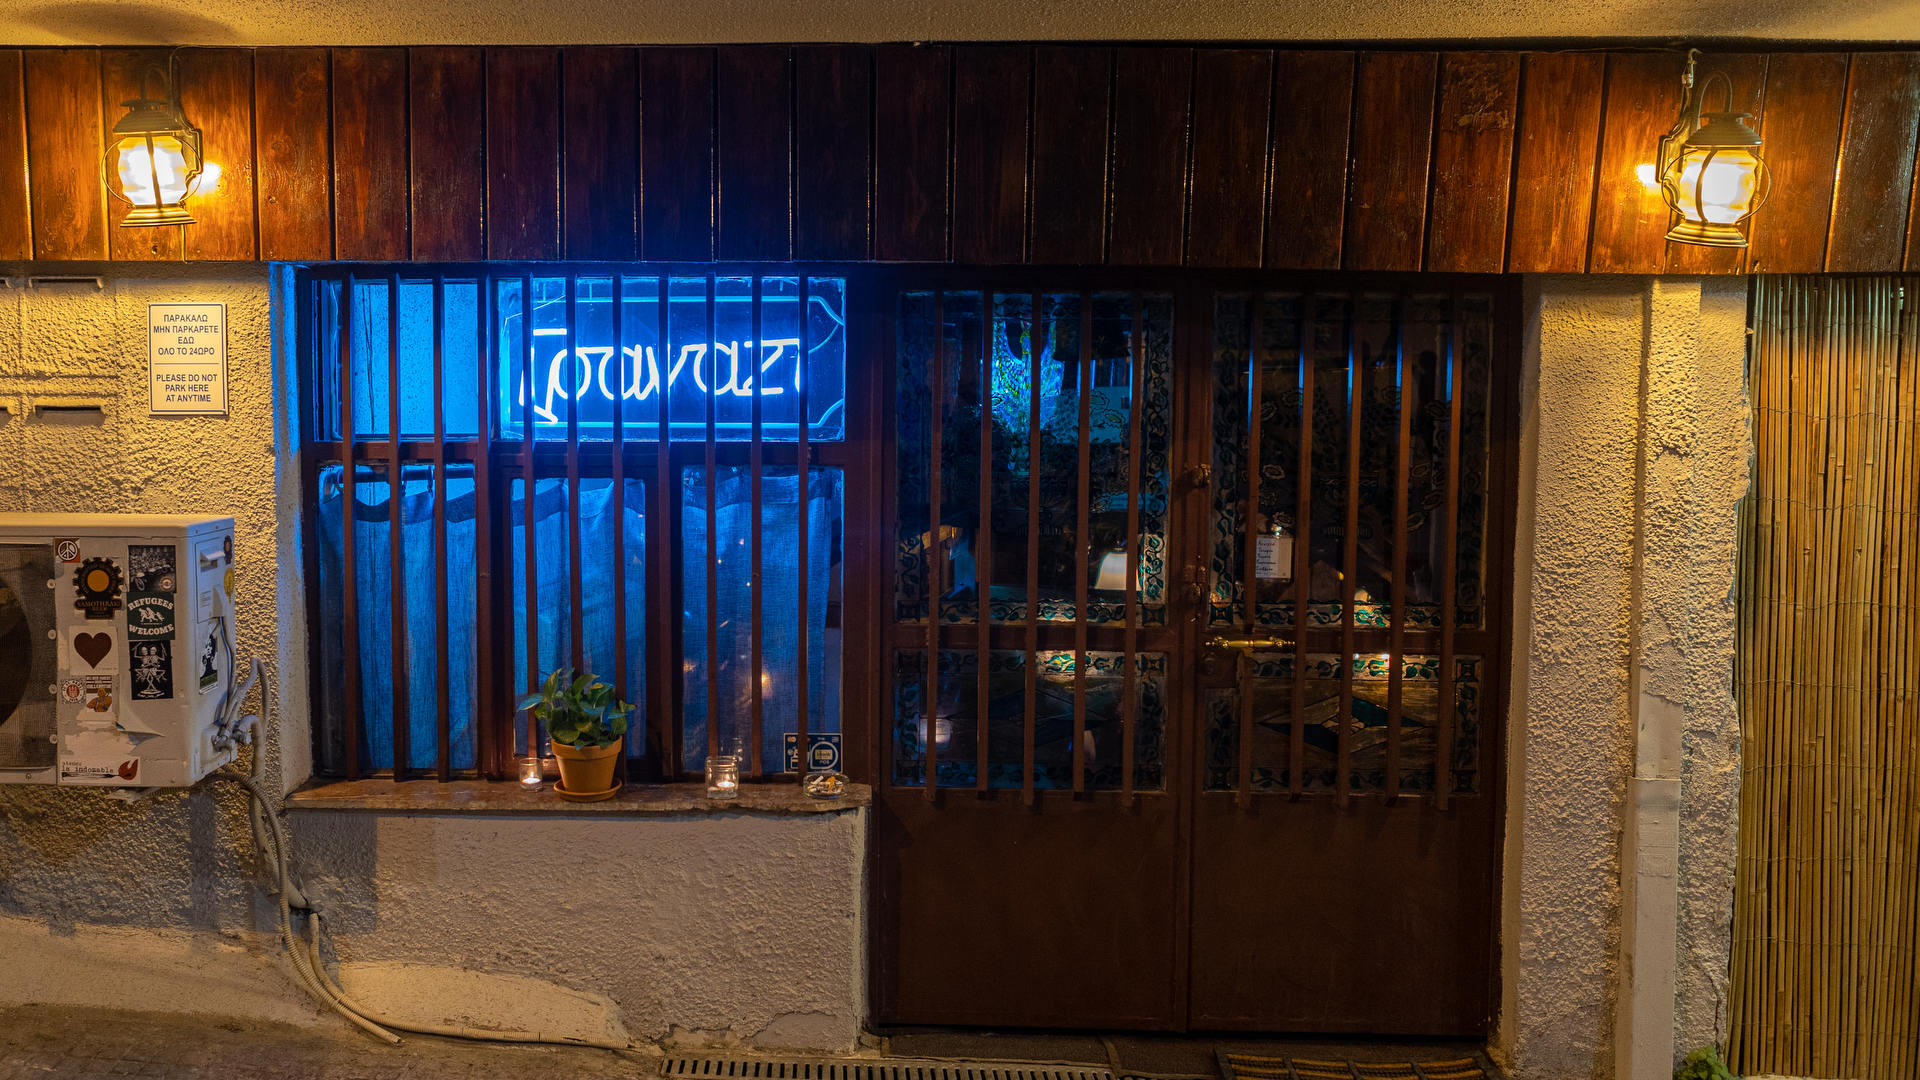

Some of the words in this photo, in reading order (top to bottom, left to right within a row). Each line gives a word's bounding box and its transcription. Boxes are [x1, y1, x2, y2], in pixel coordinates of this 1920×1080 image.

[163, 314, 208, 323] ΠΑΡΑΚΑΛΩ
[153, 325, 171, 333] ΜΗΝ
[172, 325, 219, 333] ΠΑΡΚΑΡΕΤΕ
[177, 336, 195, 345] ΕΔΩ
[157, 347, 175, 356] ΟΛΟ
[177, 347, 188, 356] ΤΟ
[189, 347, 215, 355] 24ΩΡΟ
[156, 374, 186, 382] PLEASE
[188, 374, 200, 382] DO
[201, 374, 218, 382] NOT
[165, 384, 186, 392] PARK
[188, 384, 209, 392] HERE
[165, 394, 176, 402] AT
[177, 394, 211, 402] ANYTIME
[127, 597, 174, 611] REFUGEES
[128, 623, 174, 636] WELCOME
